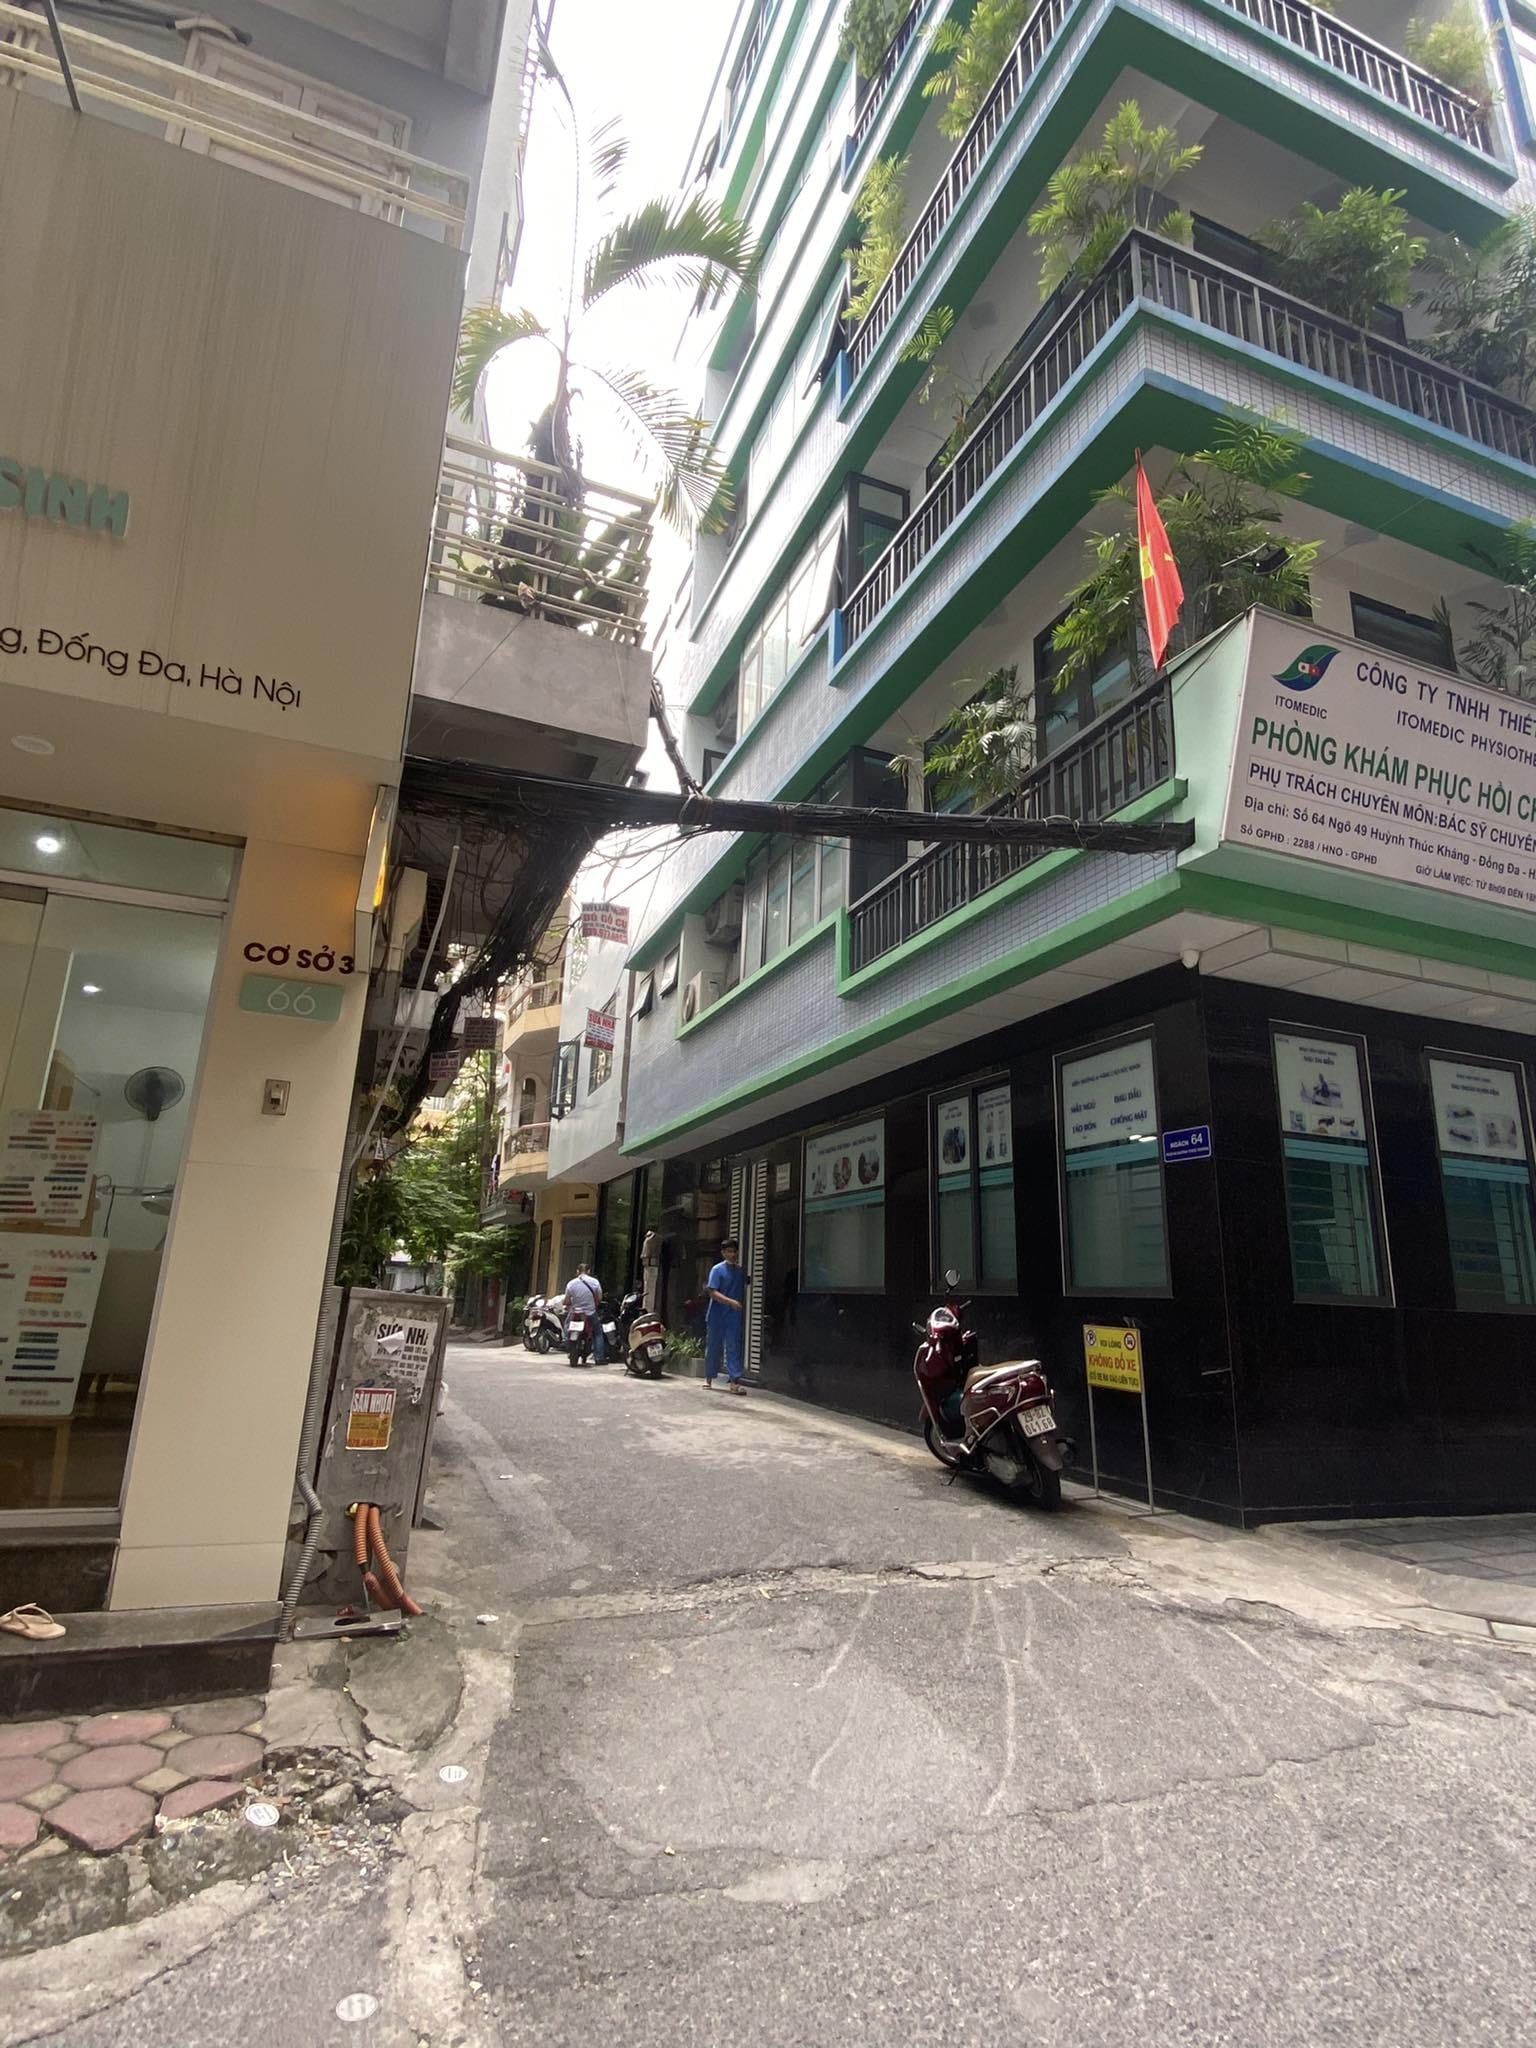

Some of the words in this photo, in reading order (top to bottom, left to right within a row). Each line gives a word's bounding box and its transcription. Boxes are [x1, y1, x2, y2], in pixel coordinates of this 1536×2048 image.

[37, 628, 129, 676] Đống
[138, 650, 191, 687] Đa,
[200, 663, 243, 695] Hà
[253, 675, 301, 711] Nội
[1275, 695, 1327, 719] ITOMEDIC
[1357, 661, 1408, 694] CÔNG
[1417, 681, 1438, 704] TY
[1446, 691, 1490, 722] TNHH
[1397, 710, 1465, 743] ITOMEDIC
[1252, 717, 1337, 765] PHÒNG
[1344, 743, 1408, 786] KHÁM
[1414, 764, 1472, 805] PHỤC
[1478, 780, 1512, 815] HỒI
[1250, 763, 1281, 788] PHỤ
[1286, 772, 1337, 799] TRÁCH
[1341, 787, 1399, 816] CHUYÊN
[1470, 821, 1487, 839] SỸ
[1240, 824, 1253, 835] Số
[1256, 828, 1285, 843] GPHĐ
[1321, 844, 1343, 856] HNO
[1351, 851, 1378, 865] GPHĐ
[1244, 796, 1264, 812] Địa
[1268, 799, 1289, 817] chỉ:
[1293, 808, 1308, 822] Số
[1312, 812, 1325, 825] 64
[1329, 817, 1350, 834] Ngõ
[1354, 823, 1367, 836] 49
[1370, 827, 1405, 846] Huỳnh
[1408, 837, 1434, 853] Thúc
[1437, 844, 1470, 865] Kháng
[1479, 855, 1504, 874] Đống
[1507, 863, 1520, 876] Đa
[1528, 868, 1536, 880] H
[243, 942, 291, 966] CƠ
[296, 945, 336, 972] SỞ
[338, 956, 355, 974] 3
[267, 982, 315, 1015] 66
[1191, 1132, 1203, 1145] 64
[1088, 1353, 1113, 1369] KHÔNG
